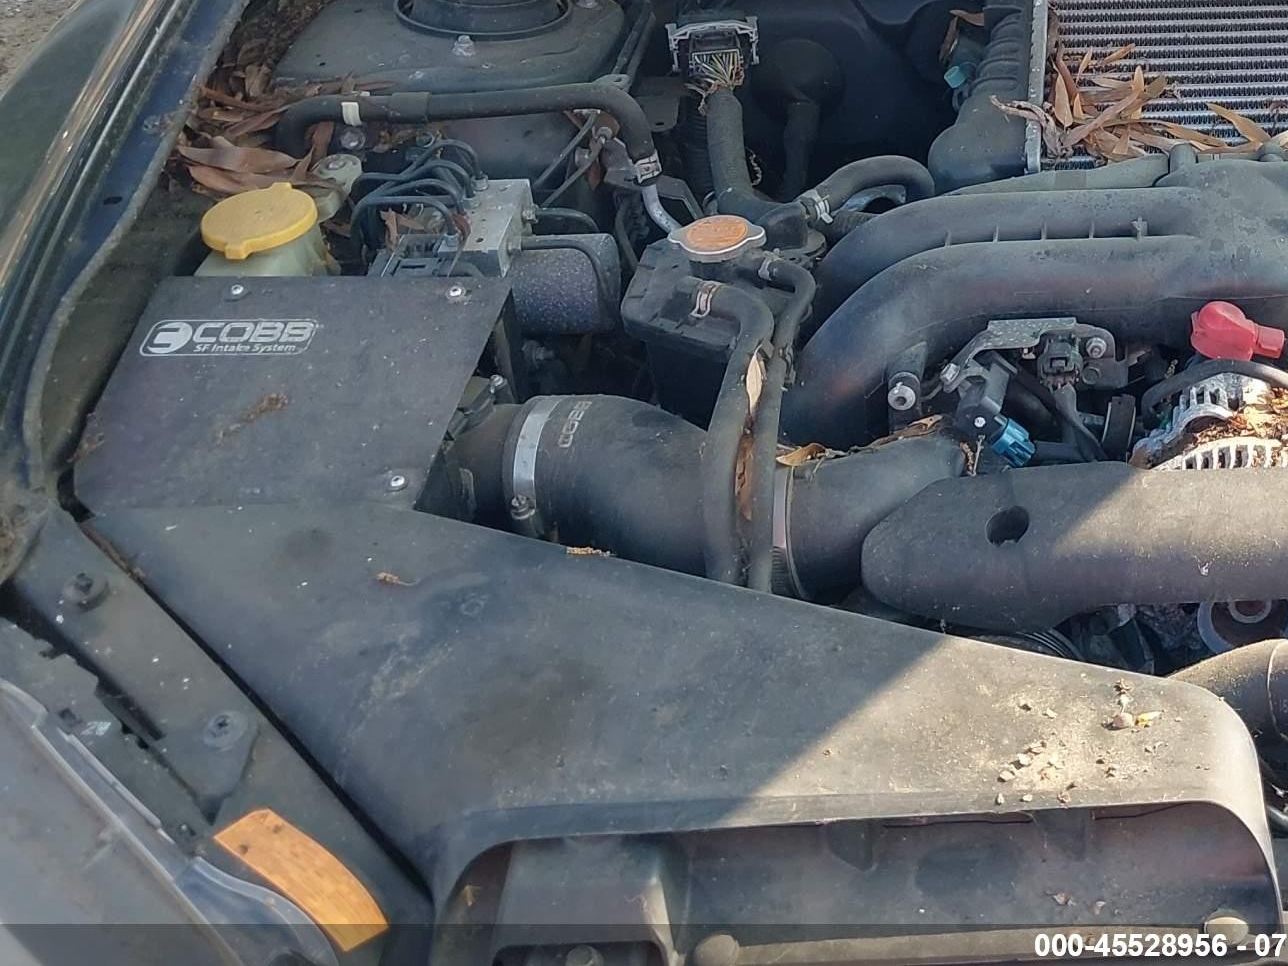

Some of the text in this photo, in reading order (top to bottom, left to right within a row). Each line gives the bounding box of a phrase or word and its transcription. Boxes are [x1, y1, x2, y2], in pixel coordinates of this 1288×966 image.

[193, 321, 316, 343] COBB
[193, 342, 297, 354] SF Intake System
